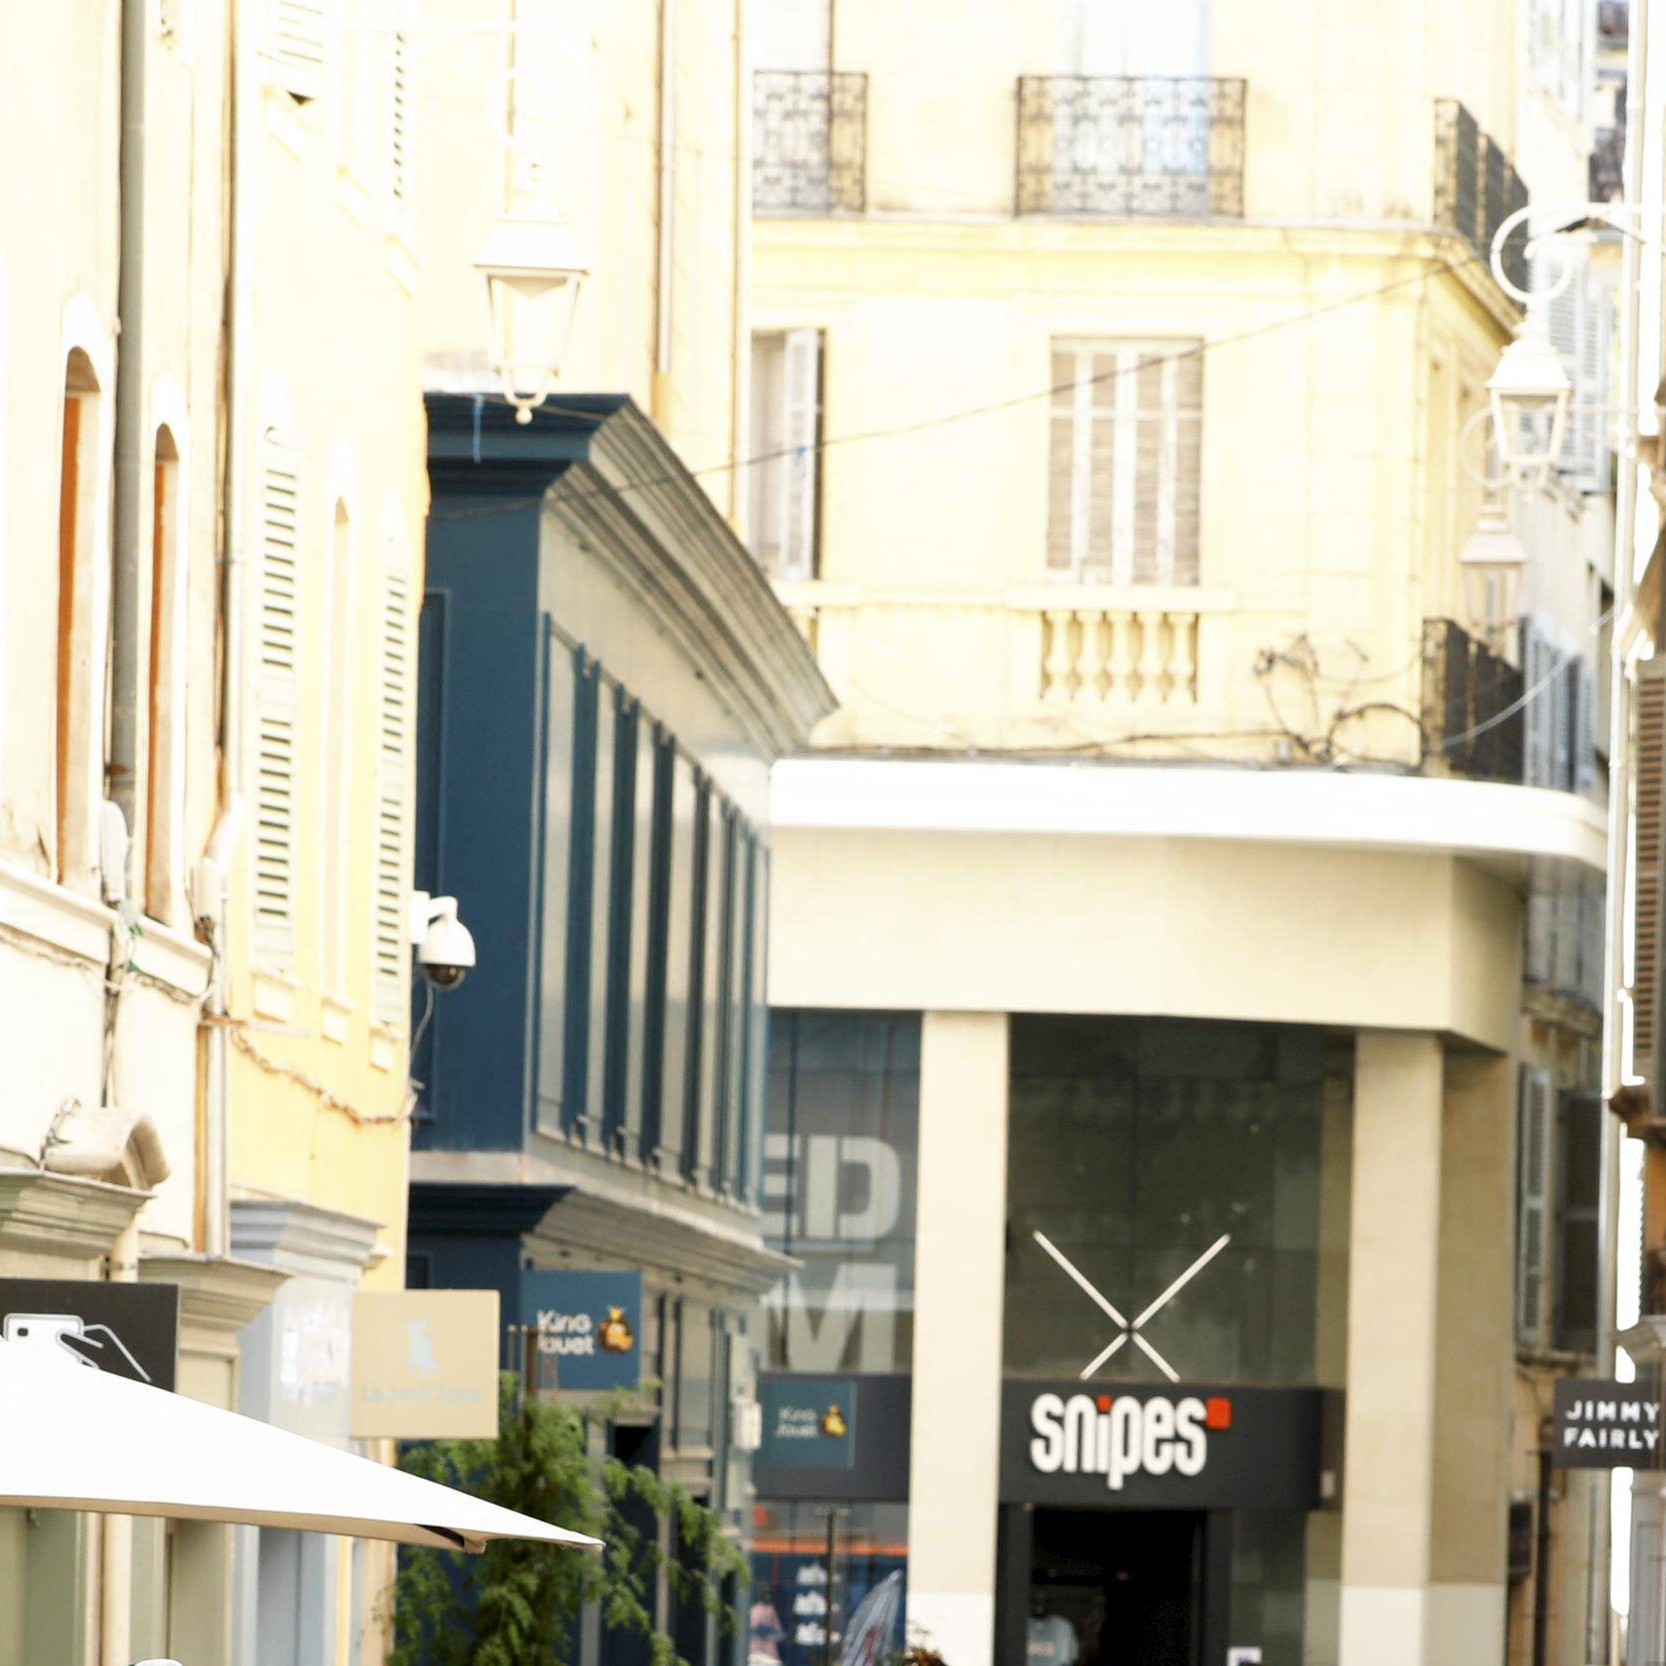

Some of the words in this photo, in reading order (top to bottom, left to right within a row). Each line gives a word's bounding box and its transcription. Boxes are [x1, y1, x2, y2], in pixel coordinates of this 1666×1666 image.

[1565, 1400, 1661, 1423] JIMMY
[1029, 1392, 1208, 1490] snipes
[1563, 1427, 1660, 1450] FAIRLY
